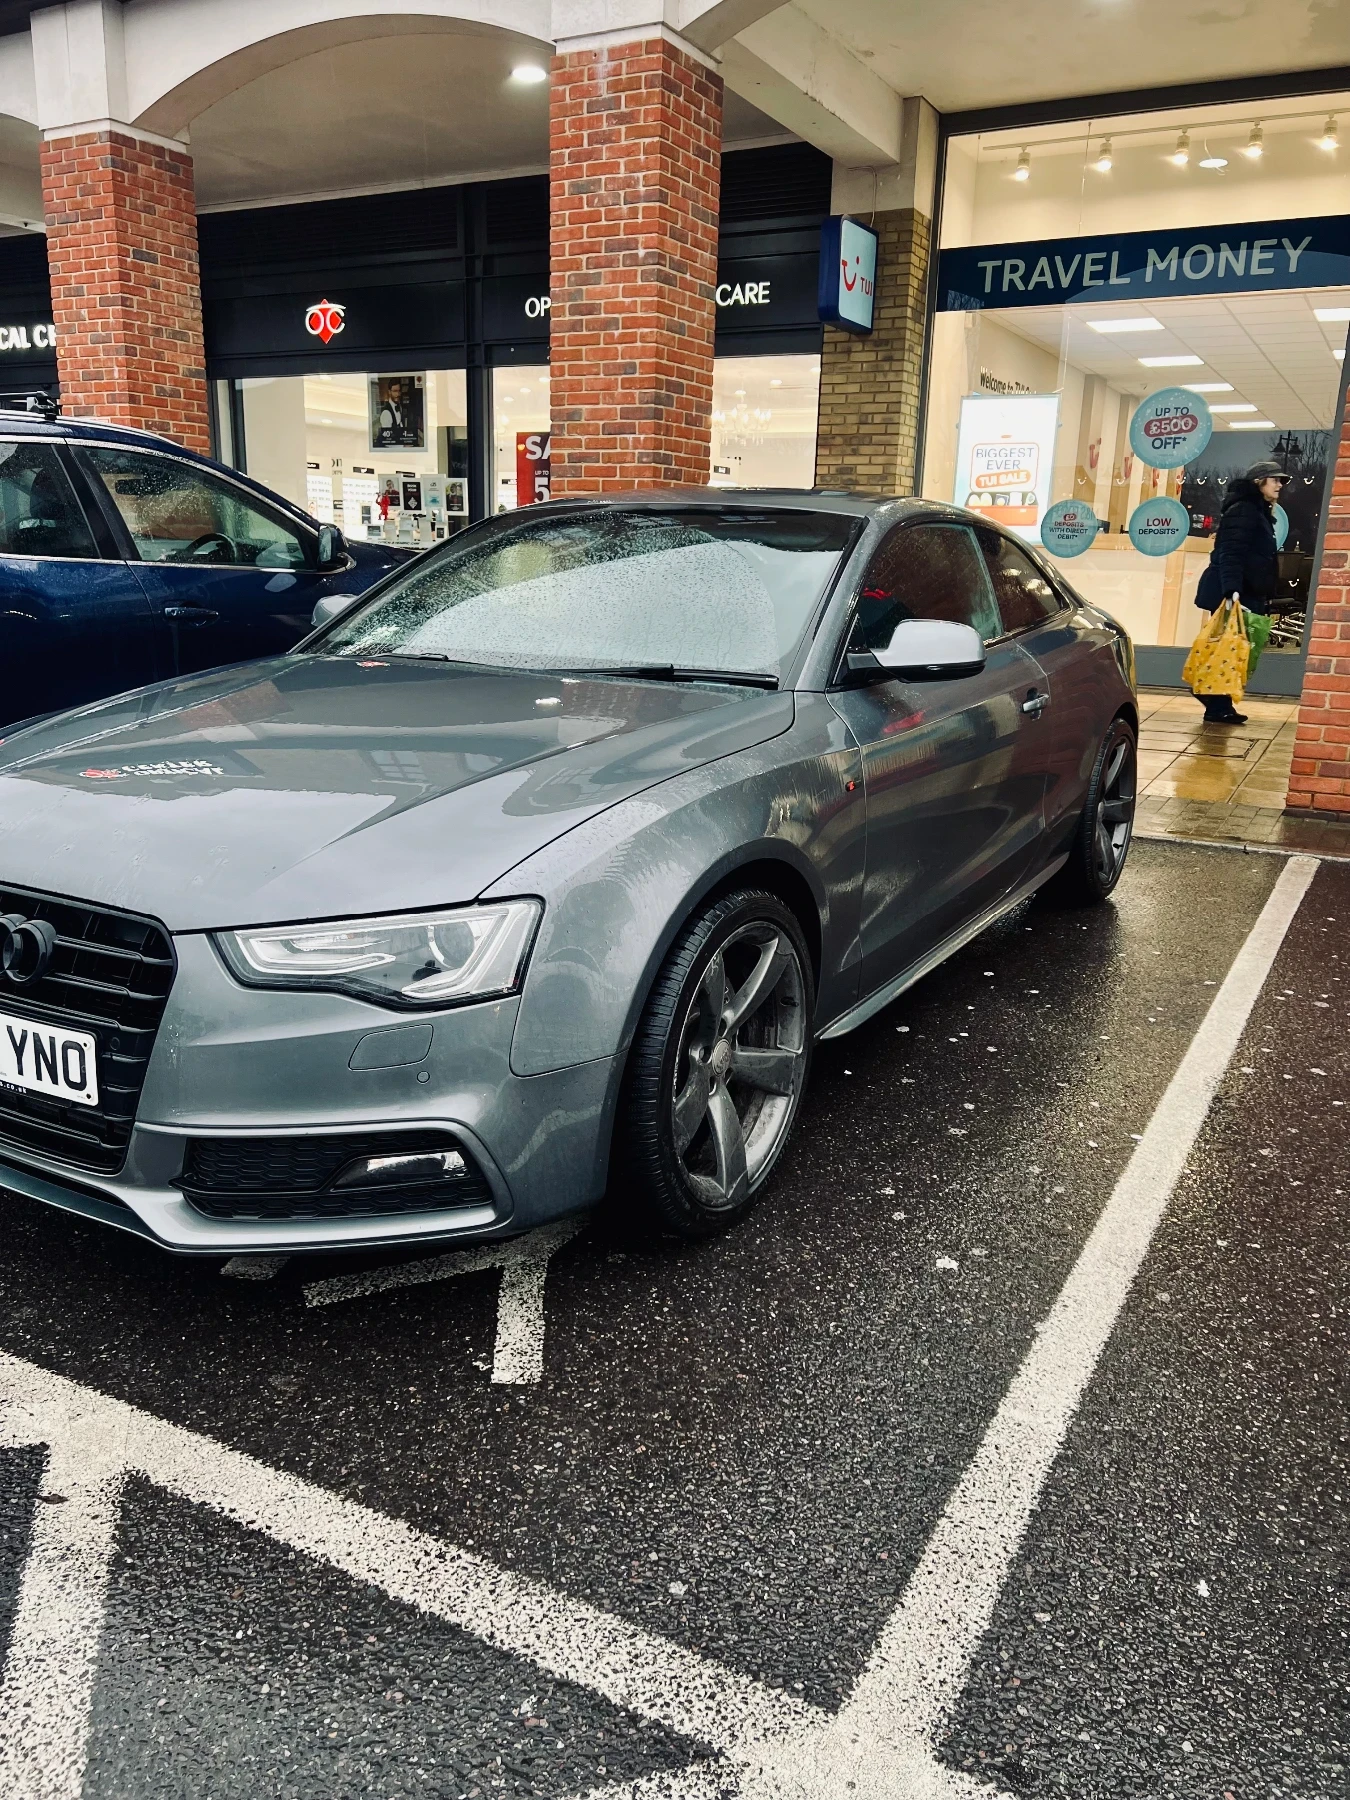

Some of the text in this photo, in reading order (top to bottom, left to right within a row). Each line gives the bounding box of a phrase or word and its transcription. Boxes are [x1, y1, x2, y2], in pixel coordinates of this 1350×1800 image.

[977, 235, 1312, 294] TRAVEL MONEY
[715, 281, 771, 307] CARE
[860, 276, 873, 297] TUI
[1155, 406, 1190, 417] UP TO
[1149, 417, 1192, 435] £500
[975, 447, 1035, 459] BIGGEST
[986, 459, 1021, 470] EVER
[978, 471, 1028, 487] TUI SALE
[1146, 517, 1172, 527] LOW
[6, 1024, 88, 1092] YNO
